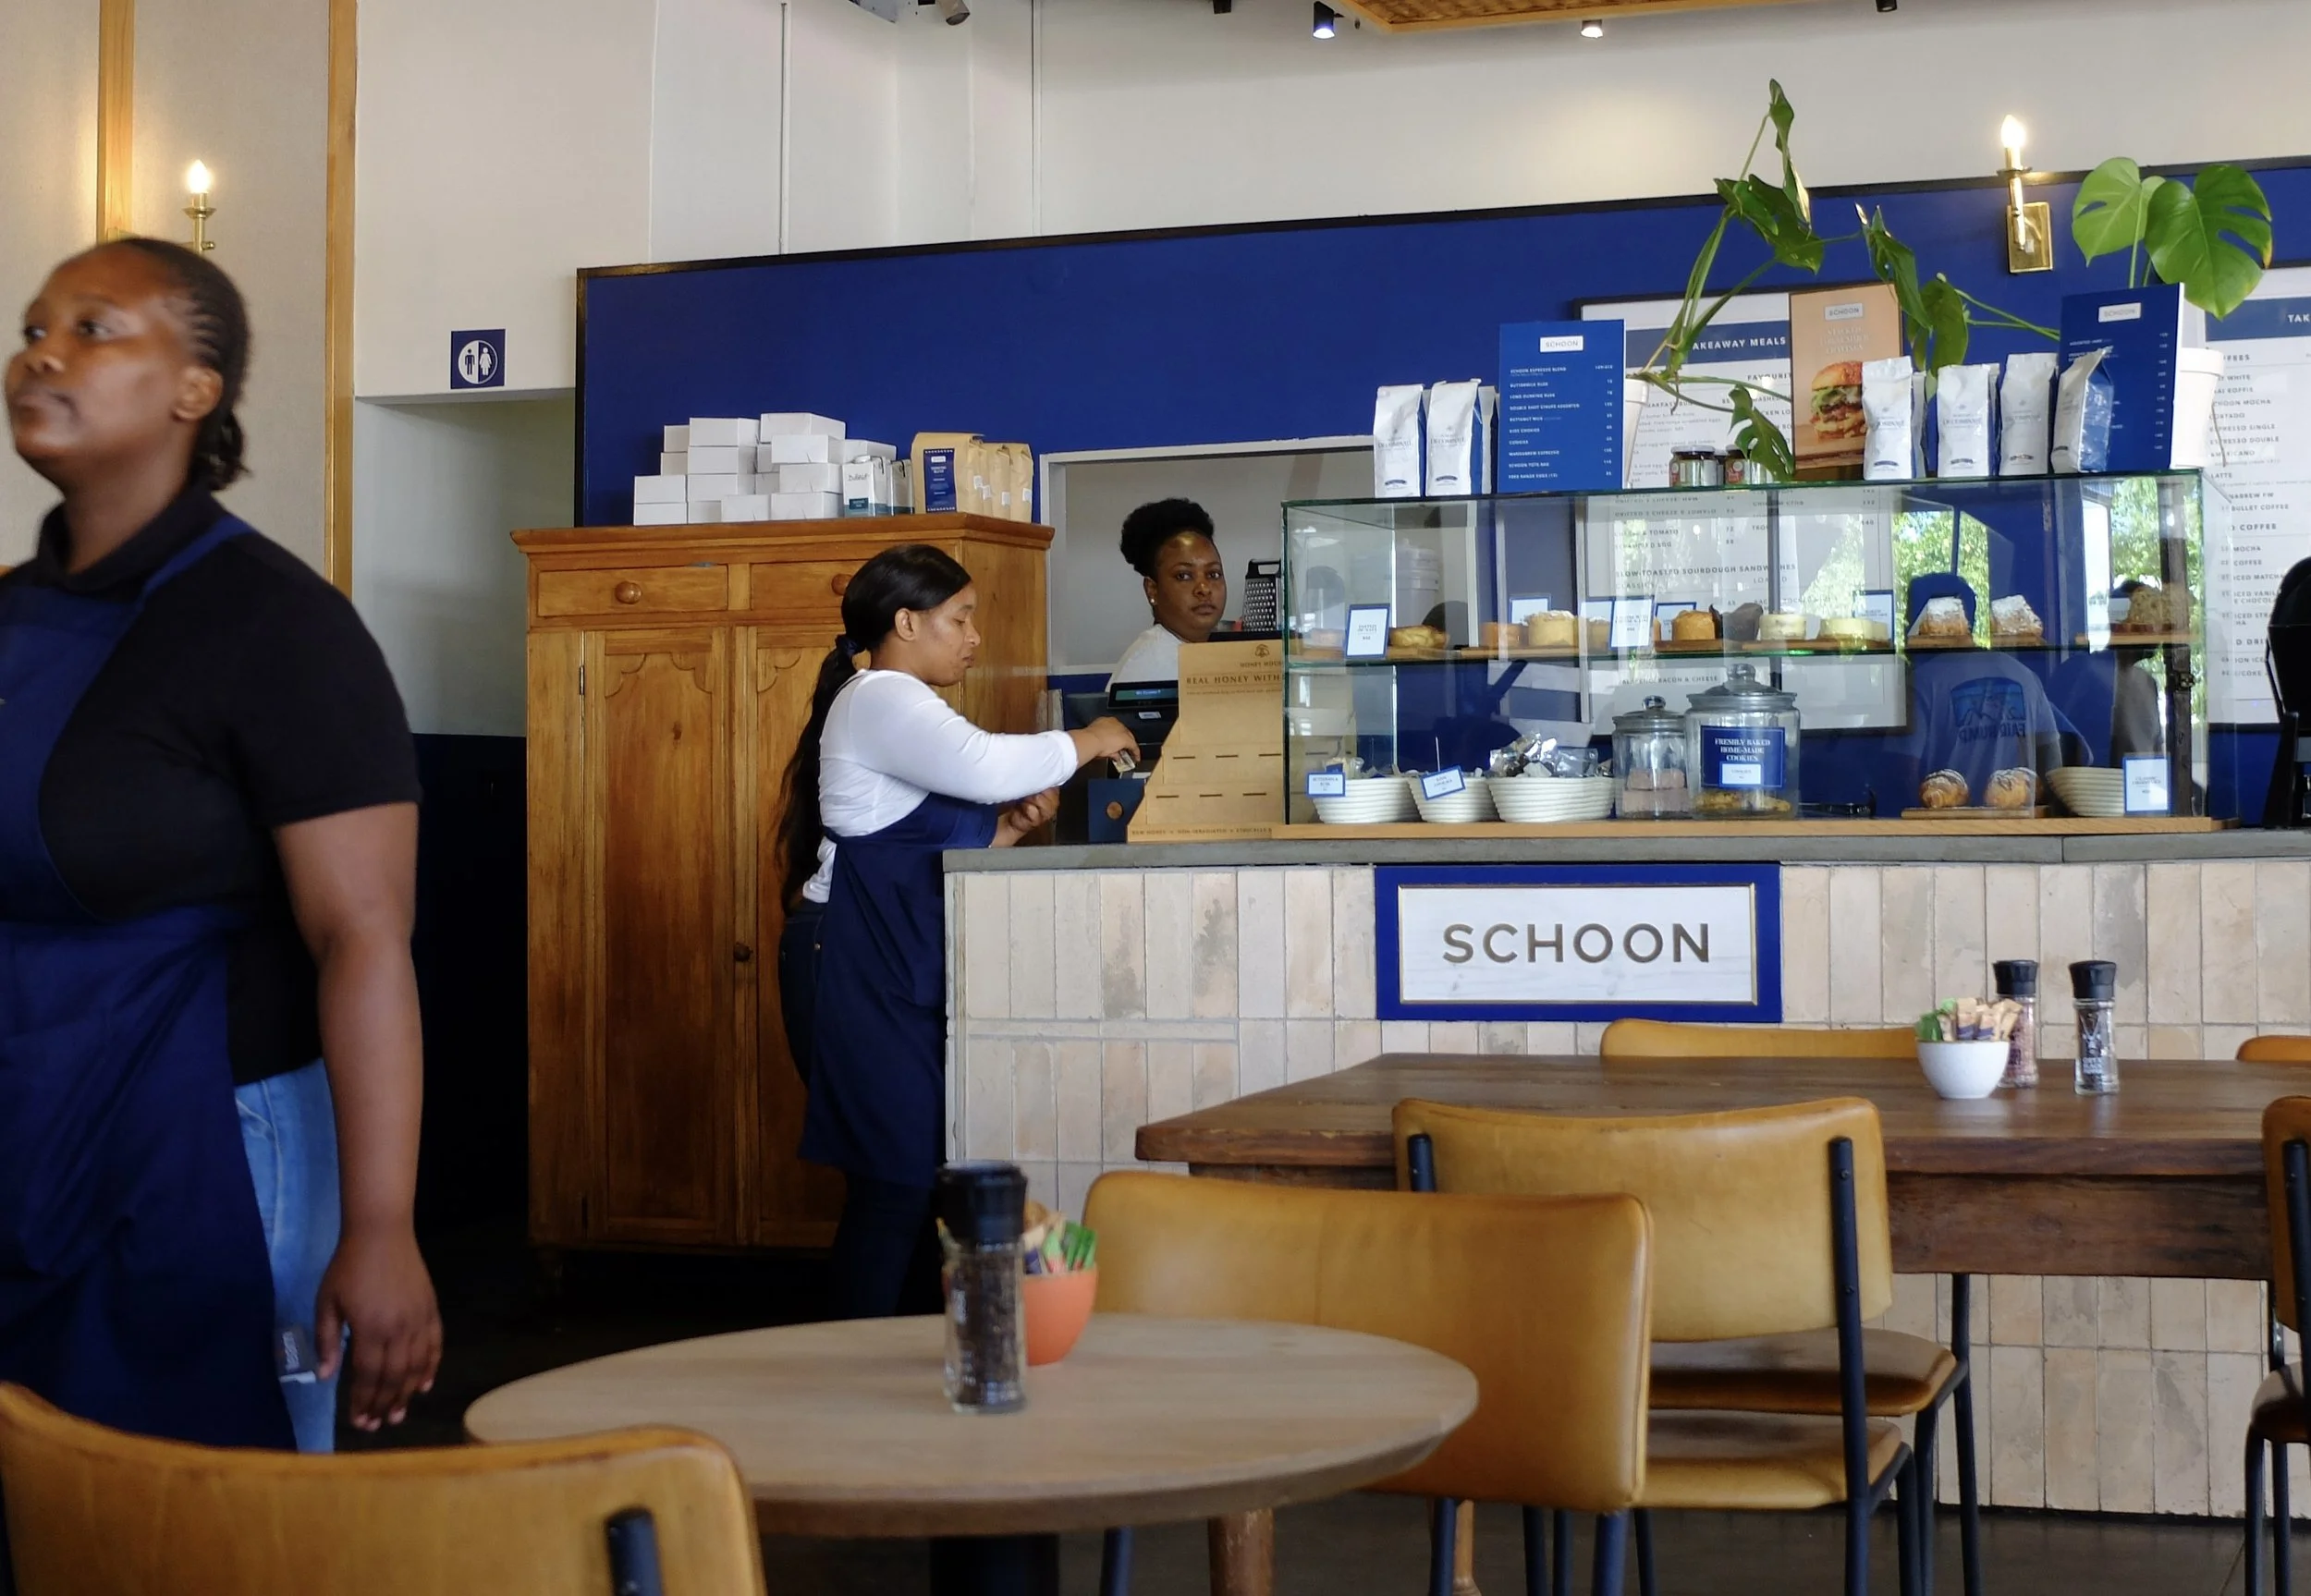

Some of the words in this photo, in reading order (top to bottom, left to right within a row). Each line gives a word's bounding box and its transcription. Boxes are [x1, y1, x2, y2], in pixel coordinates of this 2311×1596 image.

[1828, 307, 1860, 316] SCHOON
[2287, 313, 2311, 323] TAK
[1545, 339, 1579, 348] SCHOON
[1693, 339, 1745, 351] AKEAWAY
[1750, 336, 1787, 348] MEALS
[2210, 449, 2256, 457] AMRICANO
[2260, 503, 2289, 511] COFFEE
[2239, 522, 2277, 531] COFFEE
[1649, 528, 1679, 536] TOMATO
[1682, 565, 1736, 575] SOURDOUGH
[1739, 563, 1796, 573] SANDWHES
[1186, 676, 1209, 685] REAL
[1214, 675, 1248, 684] HONEY
[1253, 674, 1279, 682] WITH
[1715, 737, 1745, 746] FRESHLY
[1746, 737, 1771, 747] BAKED
[1719, 746, 1765, 754] HOME-MADE
[1442, 923, 1709, 963] SCHOON
